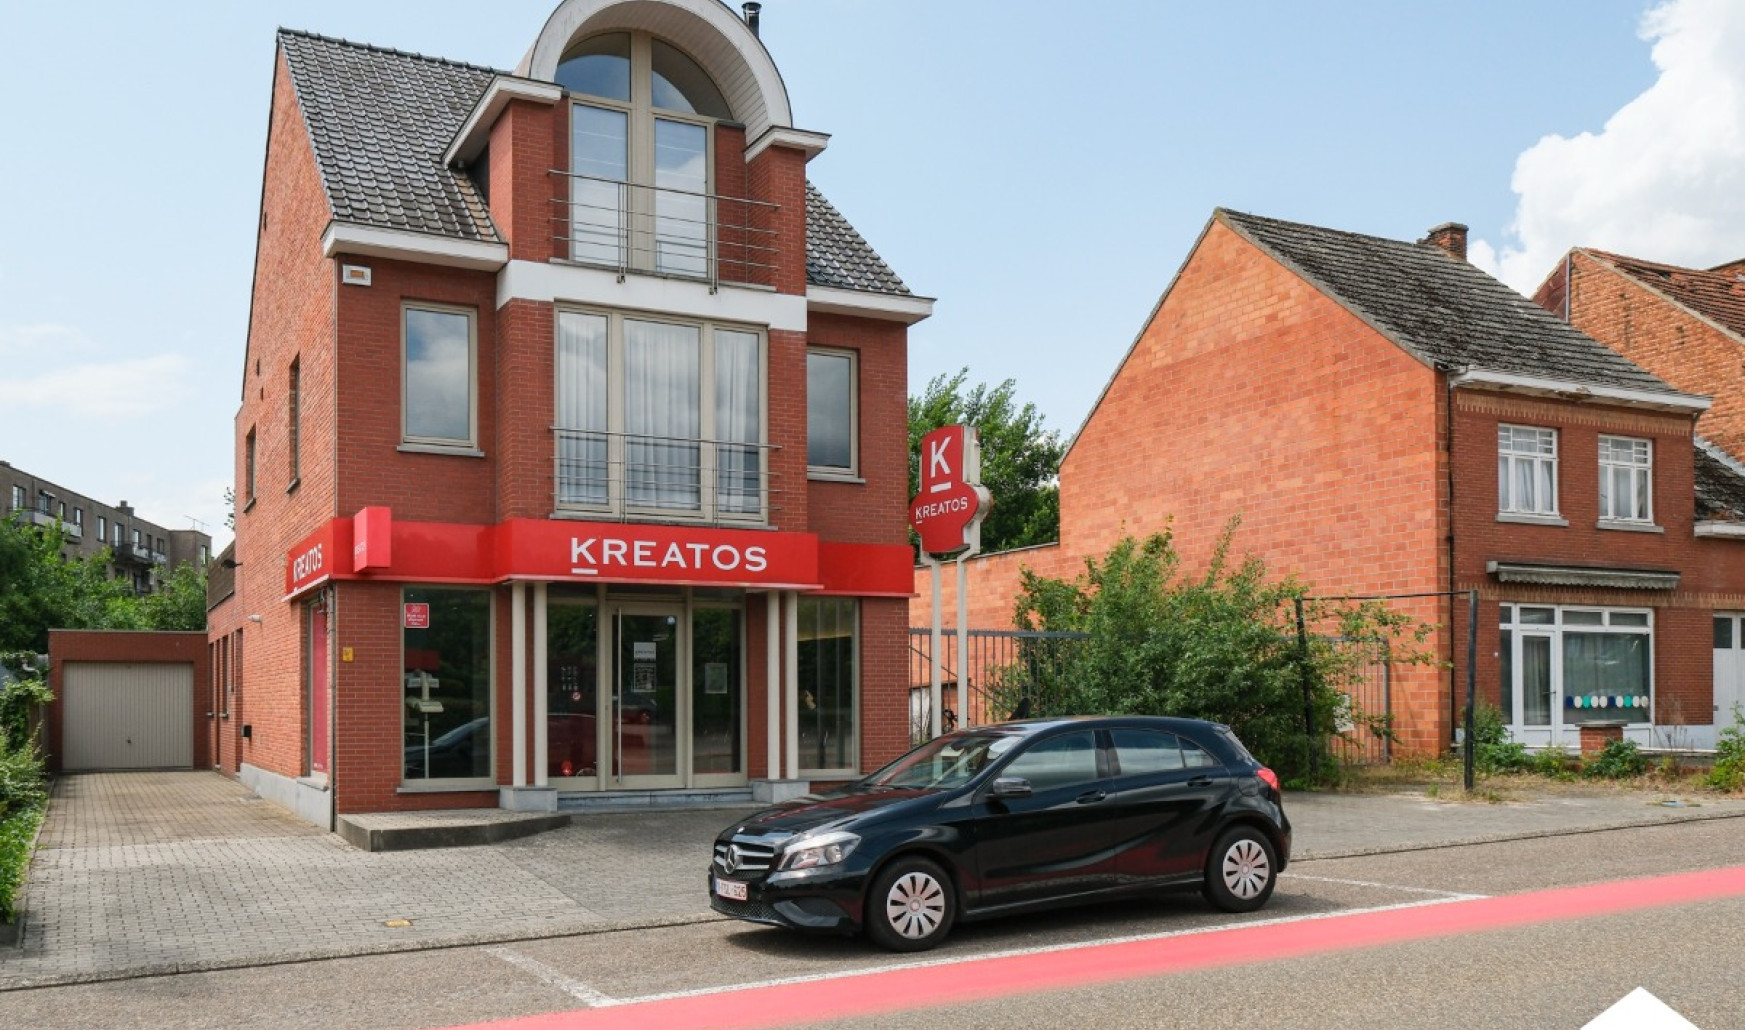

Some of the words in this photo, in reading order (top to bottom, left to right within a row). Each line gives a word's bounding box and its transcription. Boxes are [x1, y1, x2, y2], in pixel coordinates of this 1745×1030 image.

[930, 435, 951, 478] K
[915, 496, 968, 520] KREATOS
[293, 543, 322, 582] KREATOS
[571, 537, 768, 572] KREATOS
